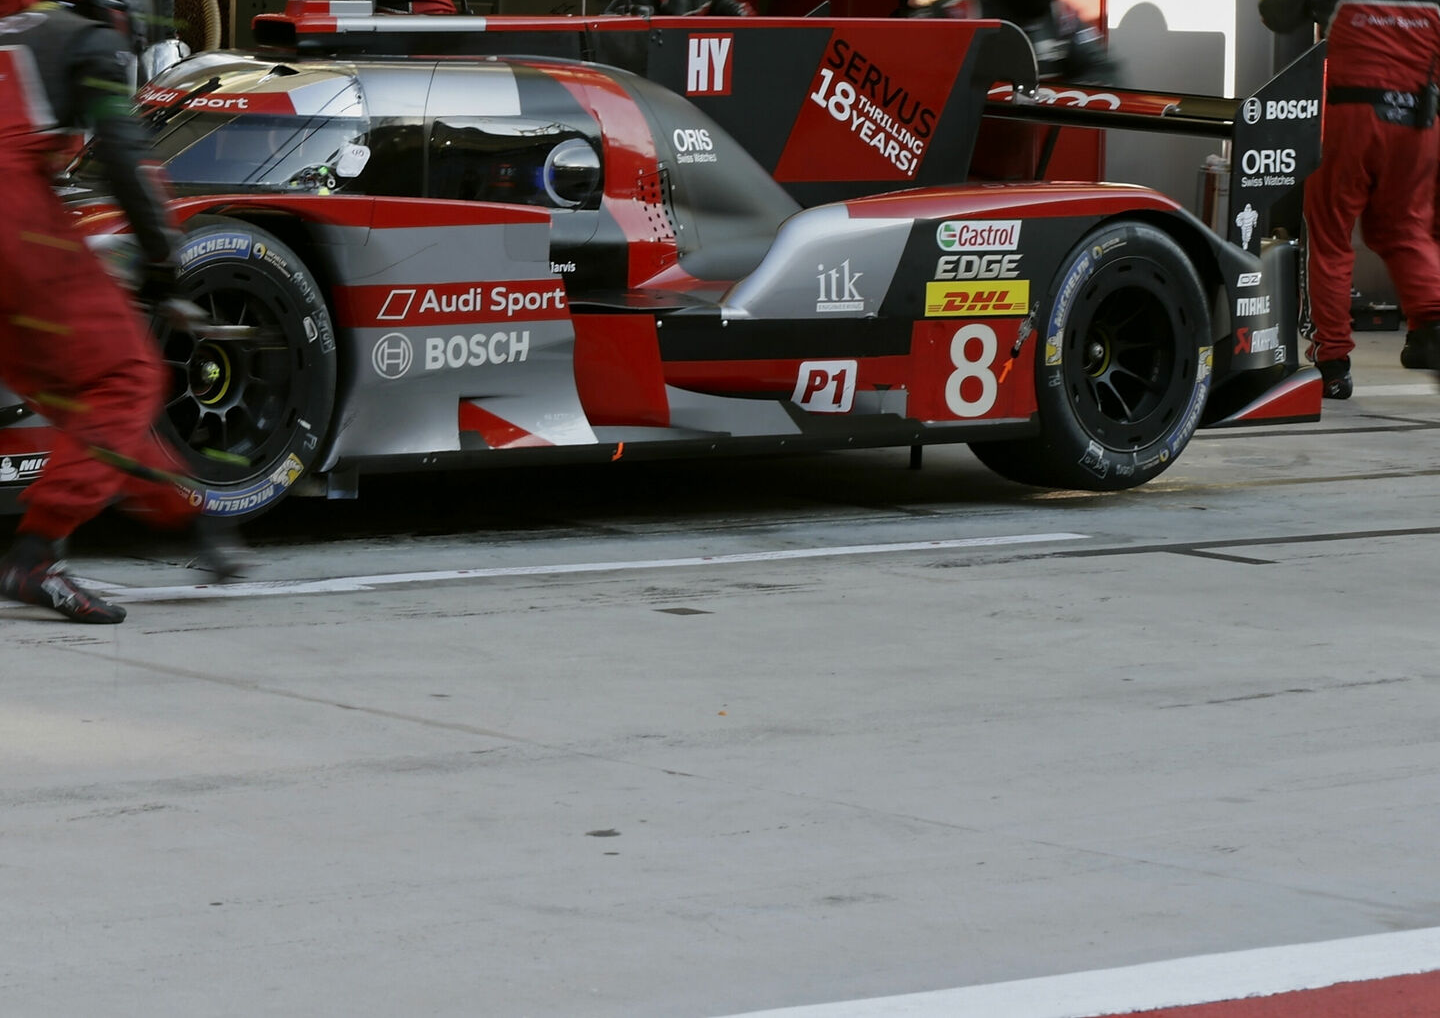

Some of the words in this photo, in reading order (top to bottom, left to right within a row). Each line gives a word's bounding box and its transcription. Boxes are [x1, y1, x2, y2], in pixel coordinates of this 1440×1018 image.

[687, 37, 731, 92] HY
[810, 67, 856, 122] 18
[827, 39, 937, 139] SERVUS
[183, 97, 249, 109] port
[1265, 99, 1319, 120] BOSCH
[858, 94, 924, 155] THRILLING
[673, 128, 713, 152] ORIS
[851, 117, 919, 177] YEARS!
[1241, 148, 1296, 175] ORIS
[1241, 176, 1263, 188] Swiss
[1264, 174, 1296, 187] Watches
[958, 220, 1016, 247] Castrol
[181, 238, 249, 265] MICHELIN
[550, 260, 576, 274] Jarvis
[816, 258, 864, 301] itk
[934, 254, 1024, 281] EDGE
[419, 288, 481, 313] Audi
[490, 286, 565, 316] Sport
[942, 290, 1015, 313] DHL
[1054, 257, 1090, 328] MICHELIN
[1236, 295, 1271, 317] MAHLE
[425, 331, 530, 370] BOSCH
[945, 323, 998, 418] 8
[800, 368, 849, 404] P1
[206, 484, 274, 511] MICHELIN
